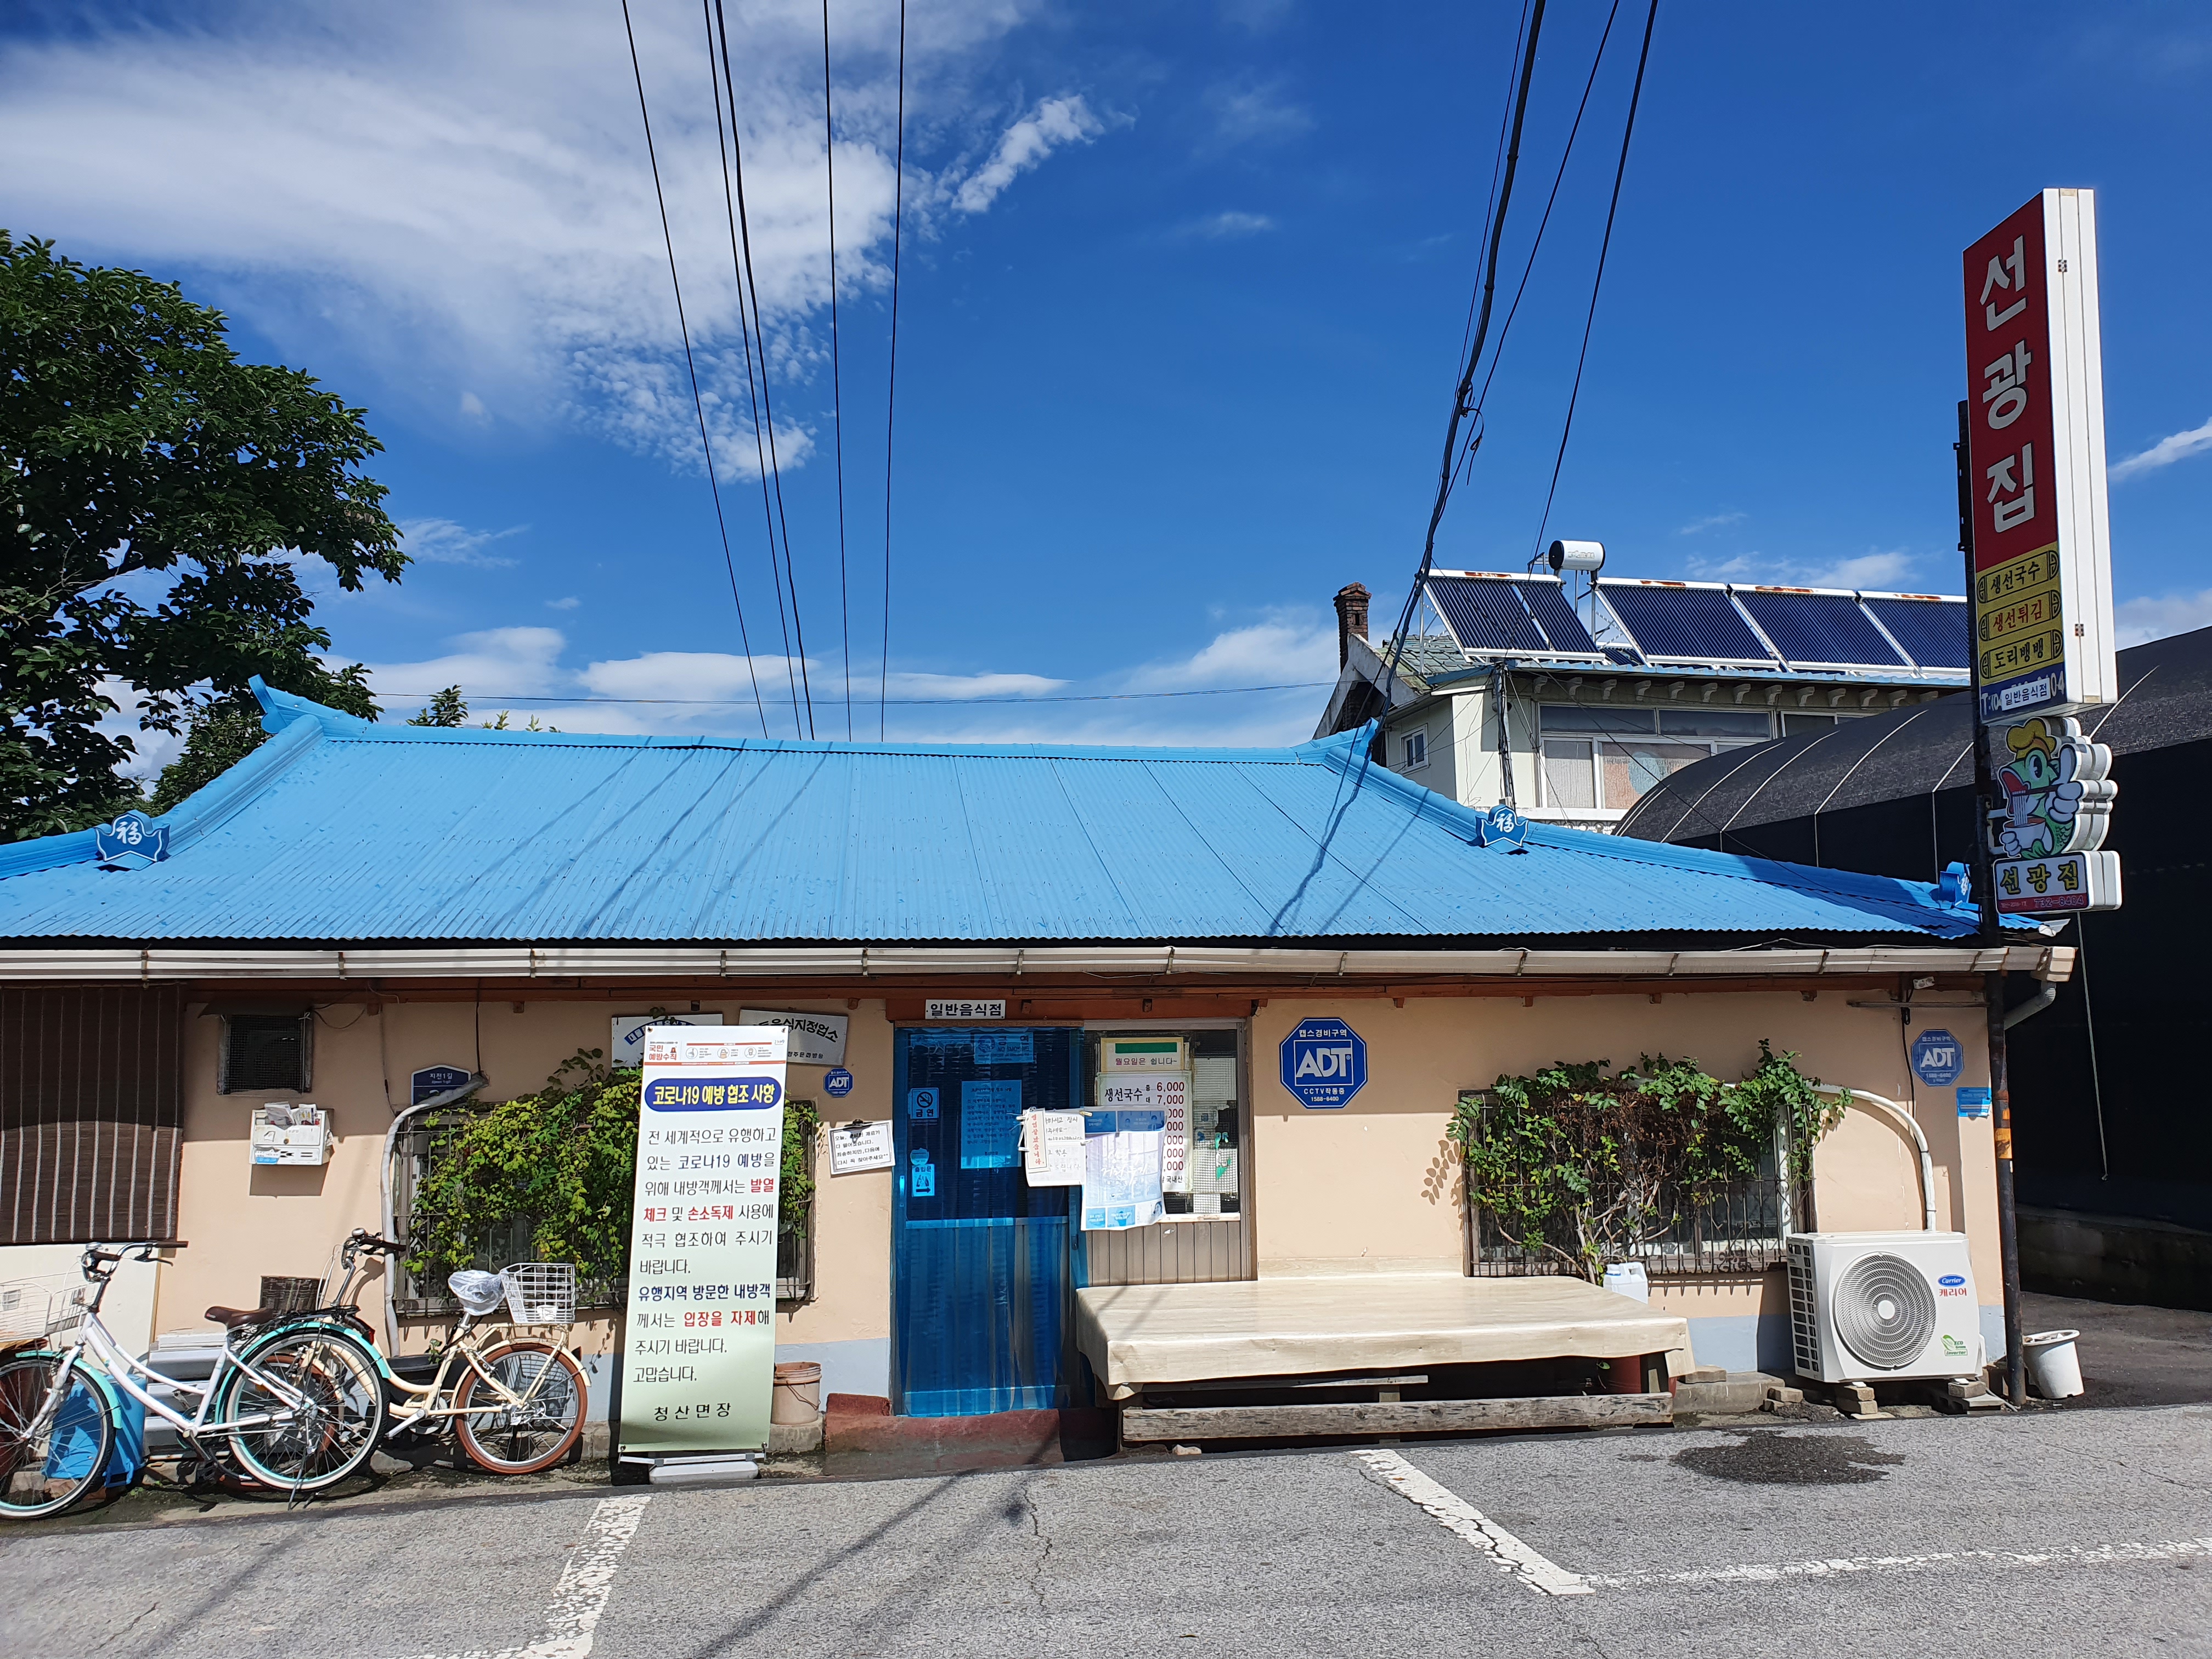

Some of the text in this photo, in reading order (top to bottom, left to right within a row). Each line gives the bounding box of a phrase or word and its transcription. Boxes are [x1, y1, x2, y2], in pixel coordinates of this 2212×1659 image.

[1980, 235, 2035, 533] 선광집
[1990, 562, 2041, 595] 생선국수
[1993, 599, 2042, 633] 생선튀김
[1994, 637, 2044, 669] 도리뱅뱅
[2005, 683, 2047, 706] 일반음식점
[1496, 813, 1514, 833] 福
[116, 821, 142, 845] 福
[2000, 861, 2079, 895] 선광집
[930, 1003, 1002, 1017] 일반음식점
[1299, 1029, 1347, 1037] 캡스경비구역
[1296, 1047, 1351, 1077] ADT
[1921, 1048, 1955, 1067] ADT
[829, 1077, 849, 1088] ADT
[653, 1083, 775, 1105] 코로나19 예방 협조 사항
[1105, 1088, 1143, 1102] 생선국수
[1156, 1082, 1184, 1092] 6,000
[1156, 1095, 1184, 1105] 7,000
[916, 1109, 934, 1118] 금연
[648, 1127, 776, 1145] 전 세계적으로 유행하고
[647, 1152, 775, 1171] 있는 코로나19 예방을
[645, 1178, 774, 1196] 위해 내방객께서는 발열
[644, 1204, 774, 1222] 체크 및 손소독제 사용에
[641, 1231, 772, 1248] 적극 협조하여 주시기
[640, 1259, 691, 1274] 바랍니다.
[638, 1283, 770, 1301] 유행지역 방문한 내방객
[1939, 1288, 1967, 1297] 캐리어
[636, 1310, 769, 1328] 께서는 입장을 자제해
[635, 1338, 727, 1356] 주시기 바랍니다.
[633, 1366, 697, 1383] 고맙습니다.
